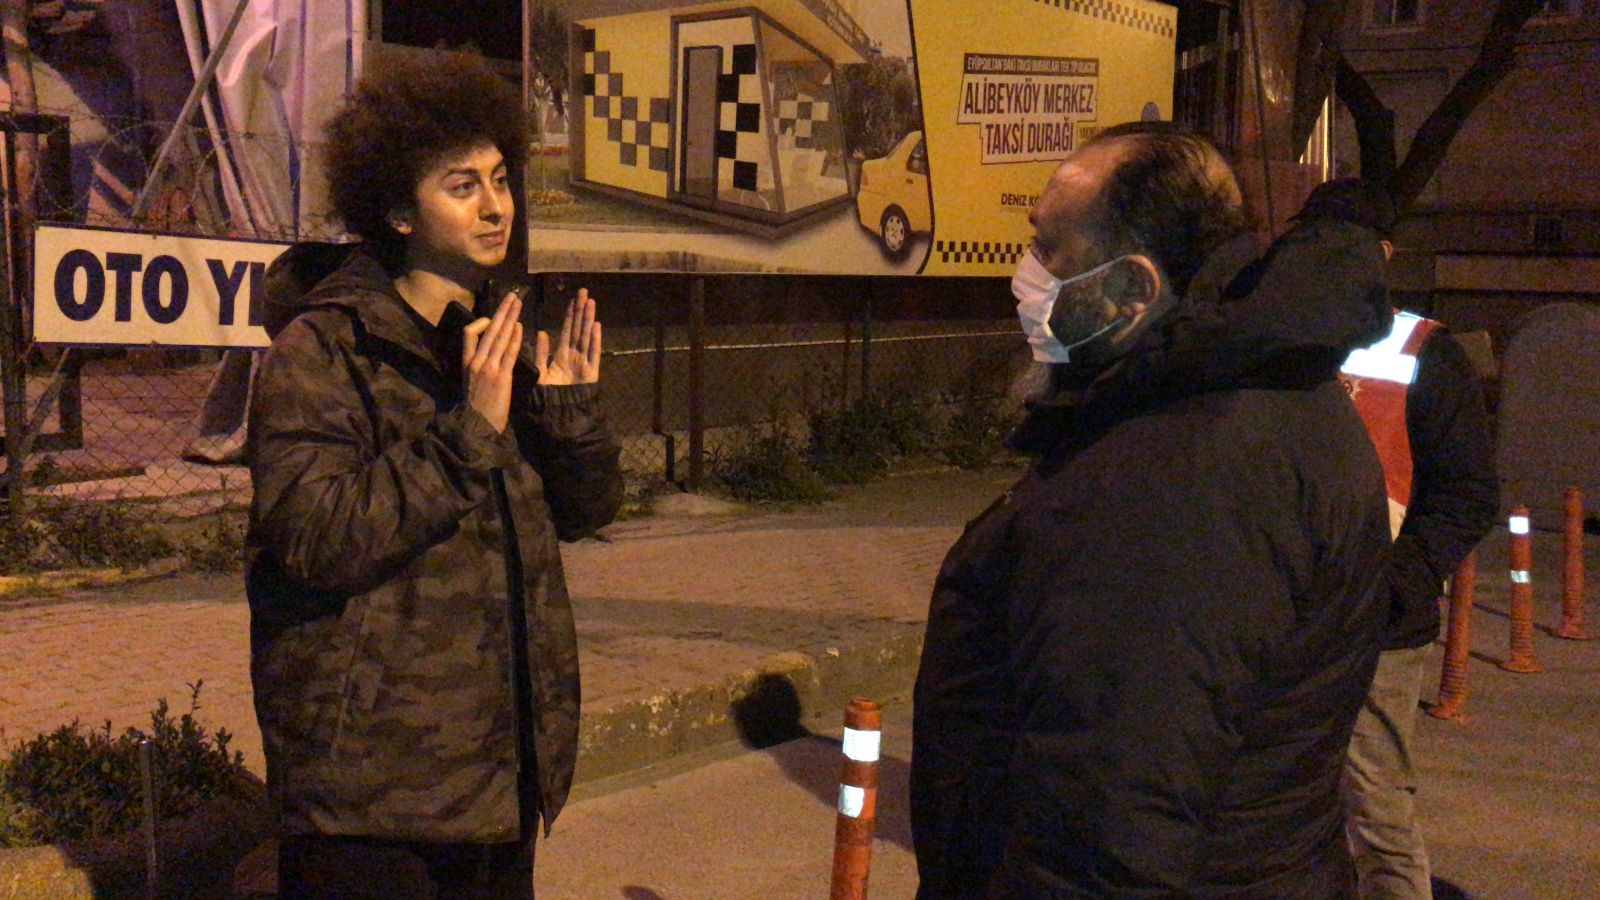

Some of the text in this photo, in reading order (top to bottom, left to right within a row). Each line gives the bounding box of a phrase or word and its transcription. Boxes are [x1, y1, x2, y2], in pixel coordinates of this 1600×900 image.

[964, 77, 1094, 114] ALİBEYKÖY MERKEZ
[985, 116, 1073, 155] TAKSİ DURAĞI
[54, 249, 189, 325] OTO
